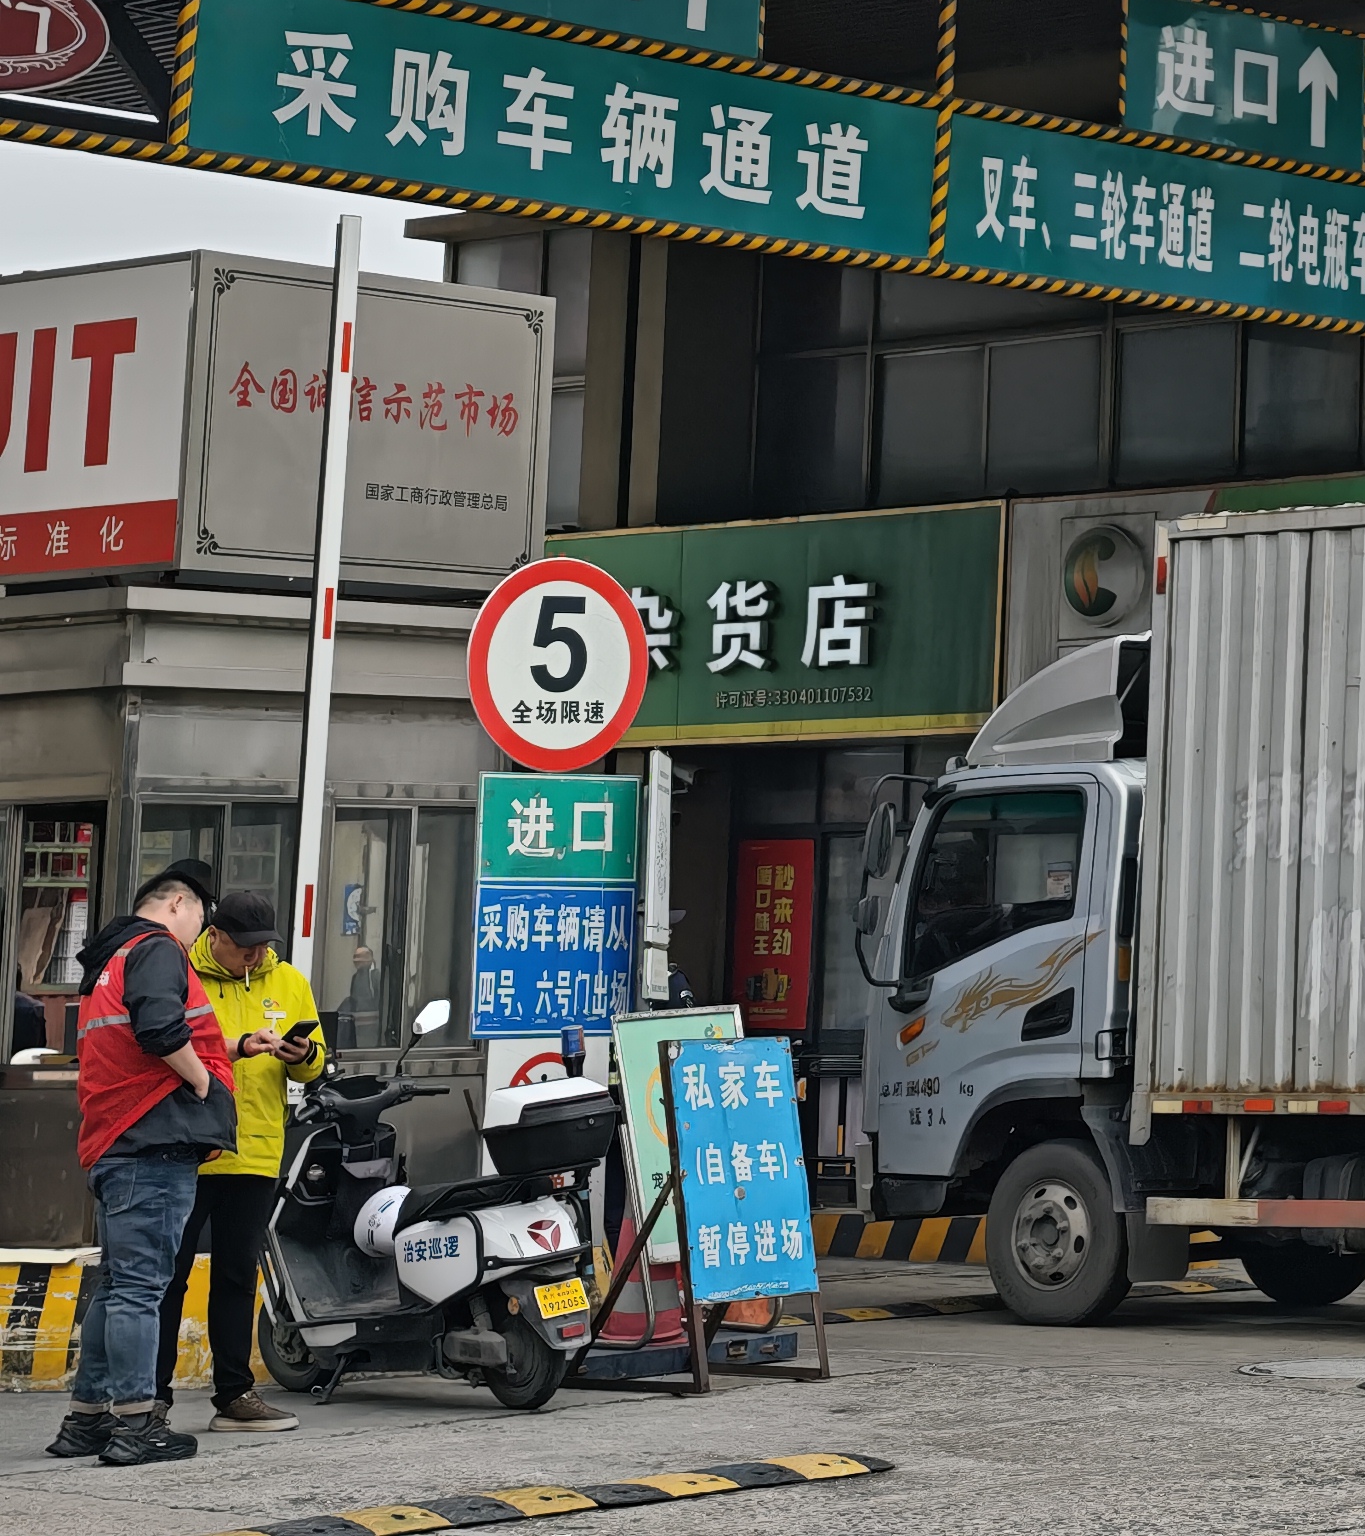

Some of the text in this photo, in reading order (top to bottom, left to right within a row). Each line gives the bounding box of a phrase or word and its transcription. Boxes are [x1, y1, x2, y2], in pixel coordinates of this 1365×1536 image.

[1156, 25, 1280, 125] 进口
[272, 30, 870, 220] 采购车辆通道
[365, 482, 509, 513] 国家工商行政管理总局
[529, 595, 588, 694] 5
[511, 699, 605, 725] 全场限速
[507, 797, 614, 858] 进口
[479, 903, 629, 953] 采购车辆请从
[477, 968, 628, 1020] 四号、六号门出场
[682, 1060, 784, 1111] 私家车
[696, 1139, 789, 1186] (自备车)
[403, 1235, 461, 1263] 治安巡逻
[698, 1219, 803, 1270] 暂停进场
